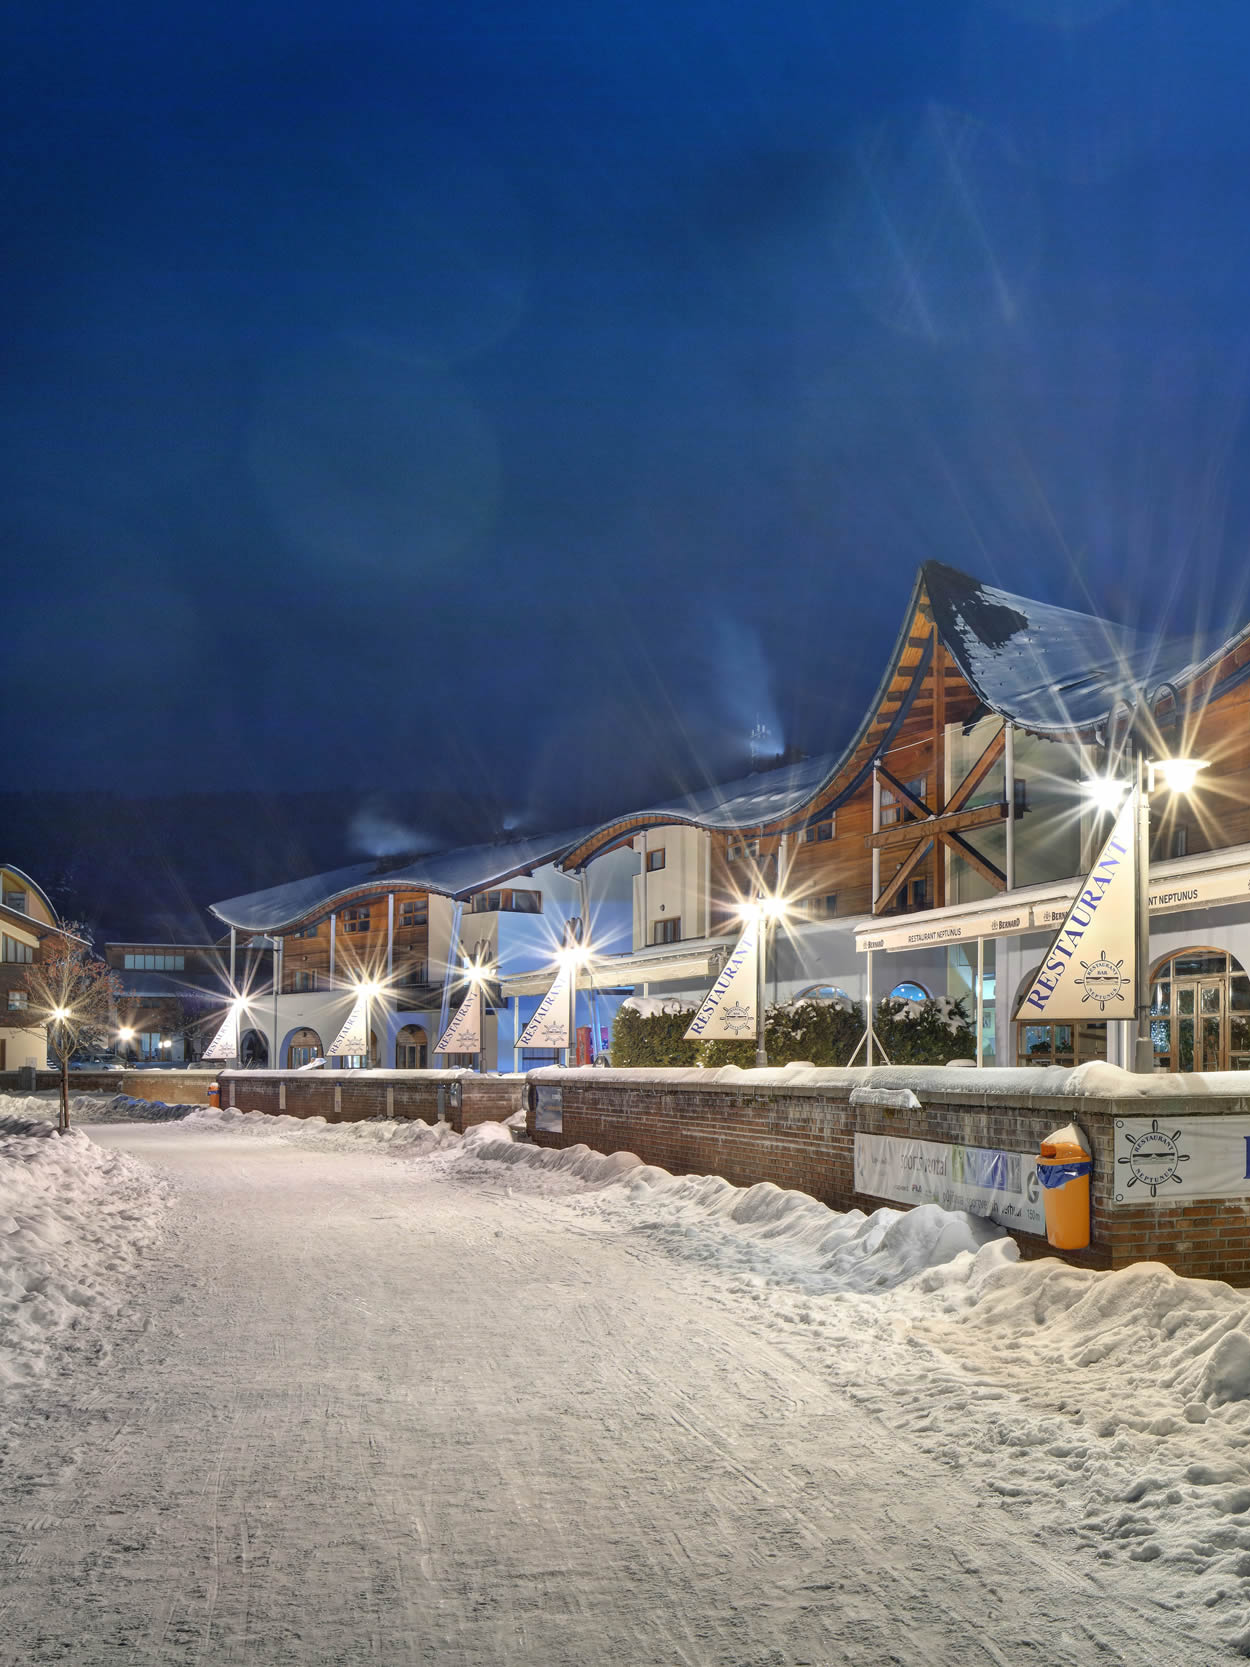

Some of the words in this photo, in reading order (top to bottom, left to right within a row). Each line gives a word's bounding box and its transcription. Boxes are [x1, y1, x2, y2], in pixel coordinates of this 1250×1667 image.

[1158, 889, 1198, 905] NEPTUNUS
[998, 917, 1021, 930] BERNARD
[1026, 836, 1128, 1012] RESTAURANT
[908, 931, 936, 943] RESTAURANT
[936, 927, 962, 940] NEPTUNUS
[690, 939, 753, 1035] RESTAURANT
[438, 991, 479, 1051] RESTAURANT
[1134, 1134, 1174, 1153] RESTAURANT
[1135, 1167, 1173, 1183] NEPTUNUS
